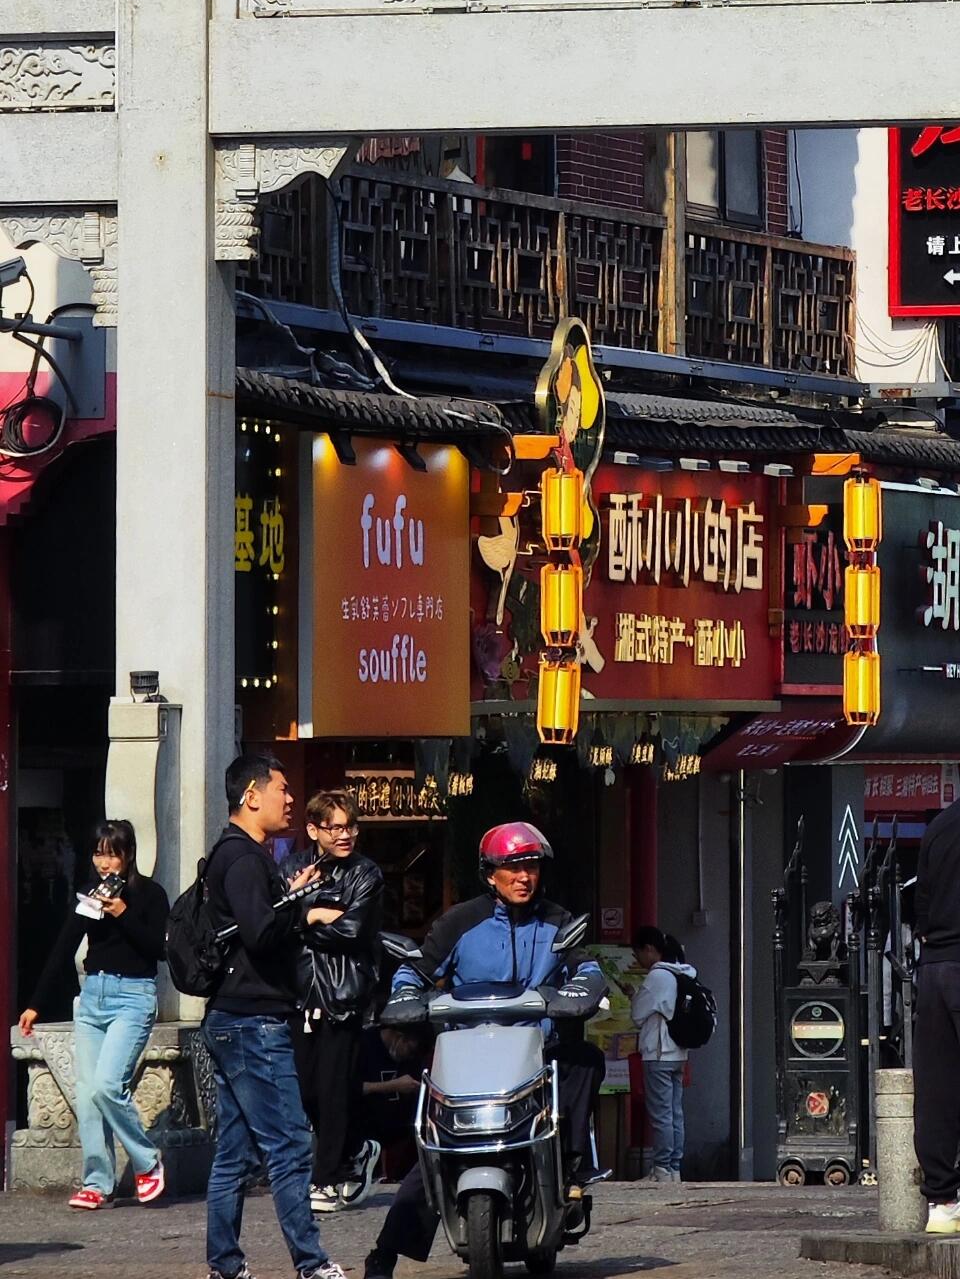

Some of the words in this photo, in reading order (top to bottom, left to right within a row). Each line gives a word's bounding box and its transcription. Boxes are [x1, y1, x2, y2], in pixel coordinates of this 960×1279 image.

[360, 493, 425, 569] fufu
[608, 492, 764, 594] 酥小小的店
[359, 633, 427, 683] souffle
